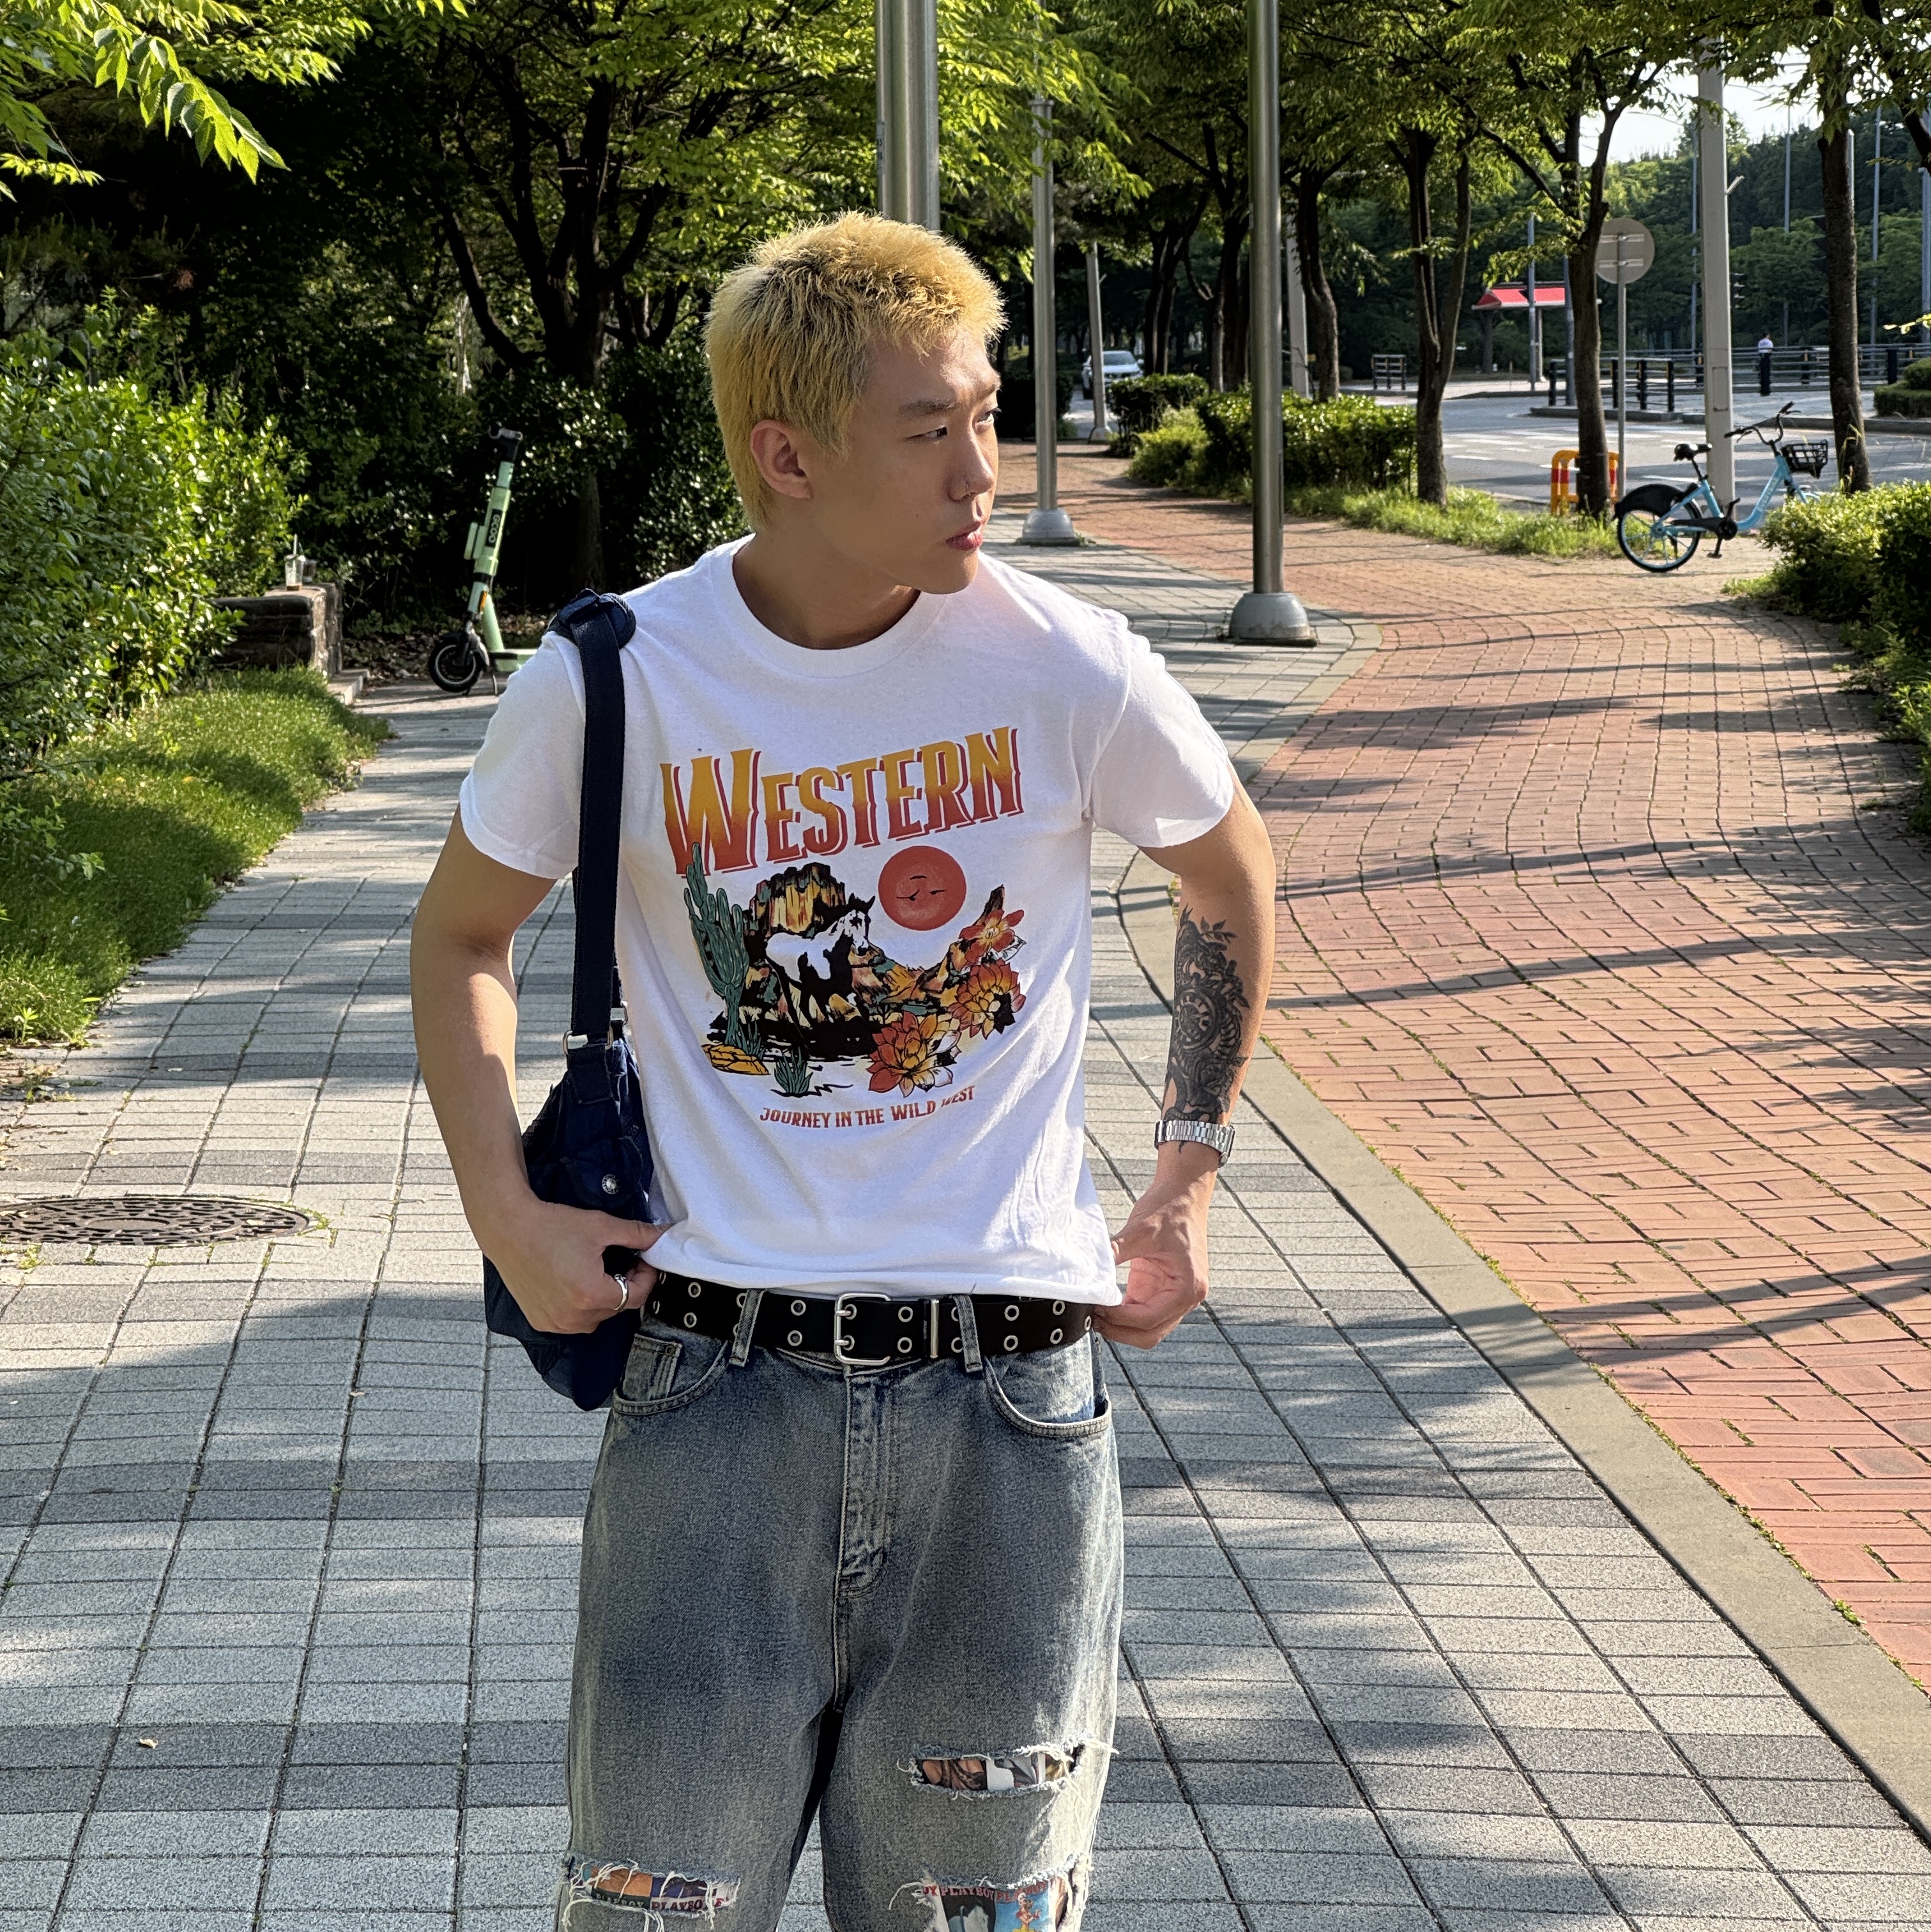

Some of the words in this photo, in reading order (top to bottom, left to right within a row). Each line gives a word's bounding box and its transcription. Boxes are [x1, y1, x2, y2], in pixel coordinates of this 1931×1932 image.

[660, 727, 1024, 877] WESTERN
[759, 1107, 831, 1129] JOURNEY
[835, 1111, 853, 1128] IN
[855, 1107, 885, 1125] THE
[890, 1100, 936, 1121] WILD
[941, 1886, 994, 1901] PLAYBOY
[652, 1899, 707, 1912] PLAYBO
